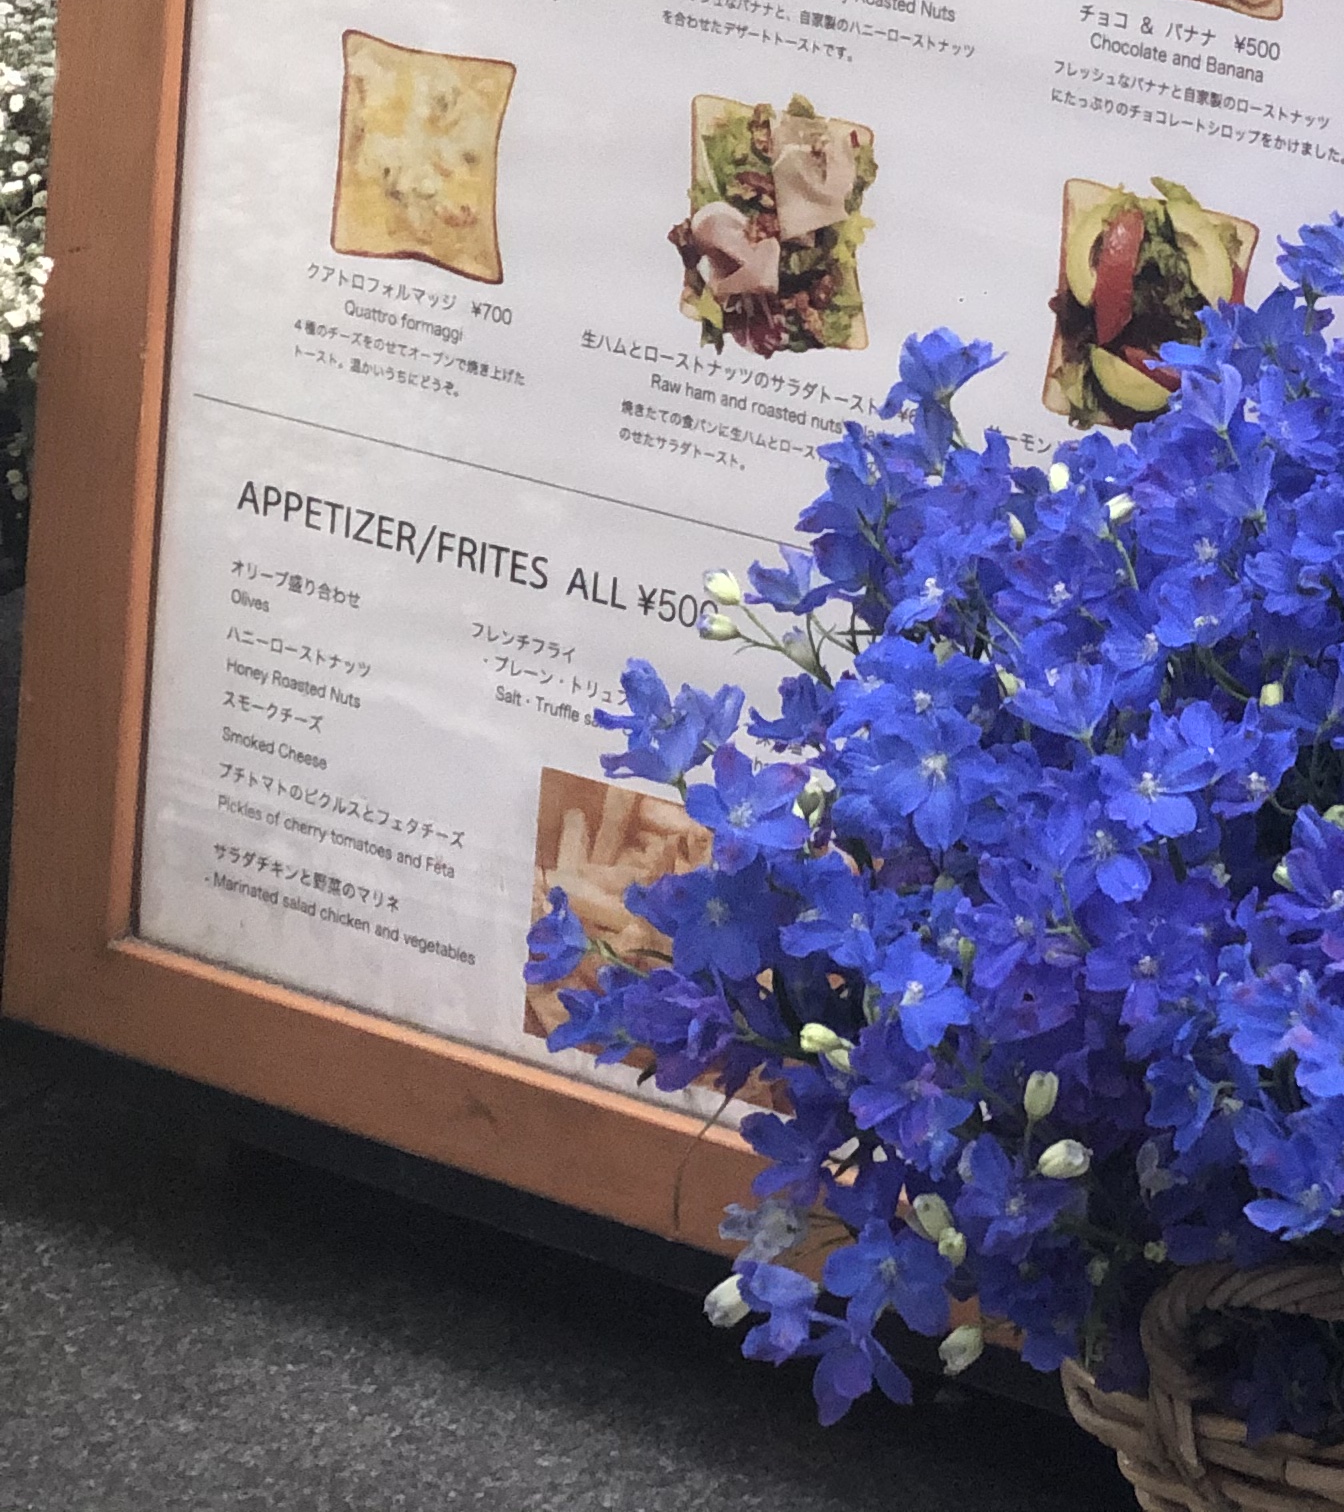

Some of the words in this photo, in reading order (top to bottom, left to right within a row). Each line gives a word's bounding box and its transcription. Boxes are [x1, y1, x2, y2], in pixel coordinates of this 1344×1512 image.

[921, 2, 956, 23] Nuts
[1080, 4, 1128, 30] チョコ
[1140, 16, 1154, 35] &
[1165, 22, 1216, 47] バナナ
[1234, 35, 1281, 61] ¥500
[1090, 32, 1167, 64] Chocolate
[1172, 48, 1201, 70] and
[1206, 56, 1264, 83] Banana
[307, 263, 457, 310] クアトロフォルマッジ
[471, 301, 512, 325] ¥700
[344, 300, 397, 326] Quattro
[400, 313, 463, 344] formaggi
[651, 373, 681, 394] Raw
[685, 382, 716, 404] ham
[720, 394, 747, 410] and
[752, 401, 806, 425] roasted
[811, 416, 842, 435] nuts
[237, 481, 549, 589] APPETIZER/FRITES
[566, 568, 626, 610] ALL
[231, 589, 270, 612] Olives
[227, 626, 371, 677] ハニーローストナッツ
[472, 623, 575, 664] フレンチフライ
[226, 658, 269, 684] Honey
[272, 670, 326, 699] Roasted
[330, 687, 361, 709] Nuts
[535, 696, 579, 722] Truffle
[222, 691, 323, 733] スモークチーズ
[222, 727, 274, 754] Smoked
[278, 743, 327, 770] Cheese
[218, 794, 262, 821] Pickles
[266, 811, 281, 826] of
[284, 818, 327, 842] cherry
[330, 830, 392, 861] tomatoes
[396, 851, 422, 869] and
[425, 858, 455, 879] Feta
[283, 891, 316, 916] salad
[320, 907, 370, 933] chicken
[375, 923, 399, 941] and
[403, 932, 475, 966] vegetables
